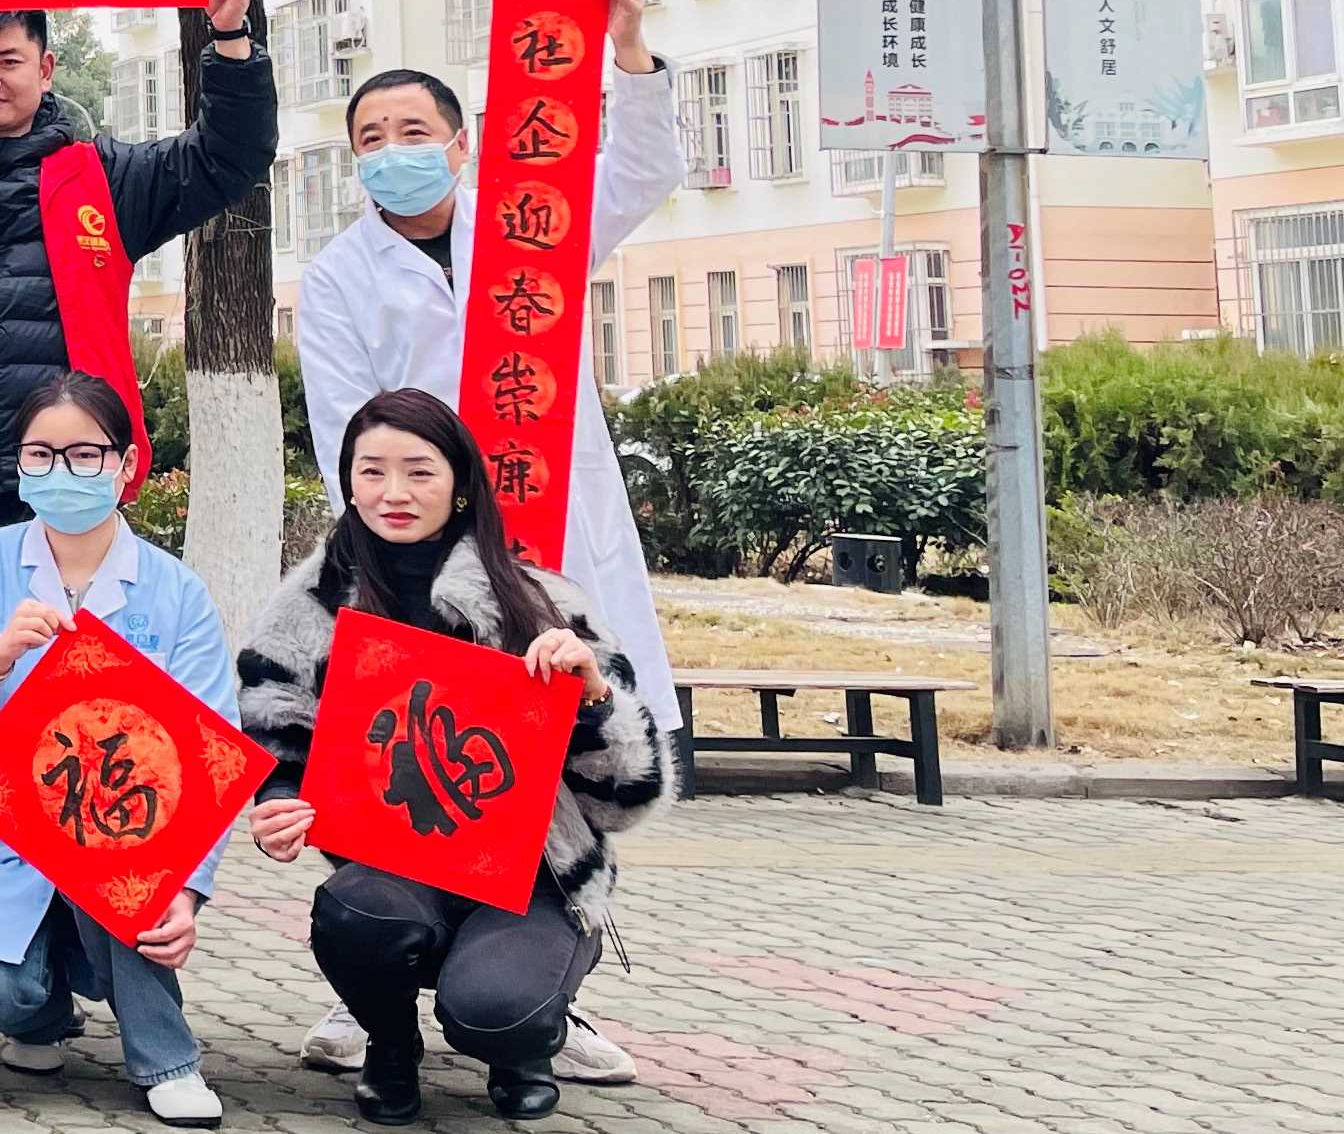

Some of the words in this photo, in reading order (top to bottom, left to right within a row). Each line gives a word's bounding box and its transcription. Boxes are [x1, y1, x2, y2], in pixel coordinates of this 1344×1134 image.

[488, 19, 573, 564] 社企迎春崇廉
[40, 732, 157, 848] 福
[367, 678, 515, 839] 福
